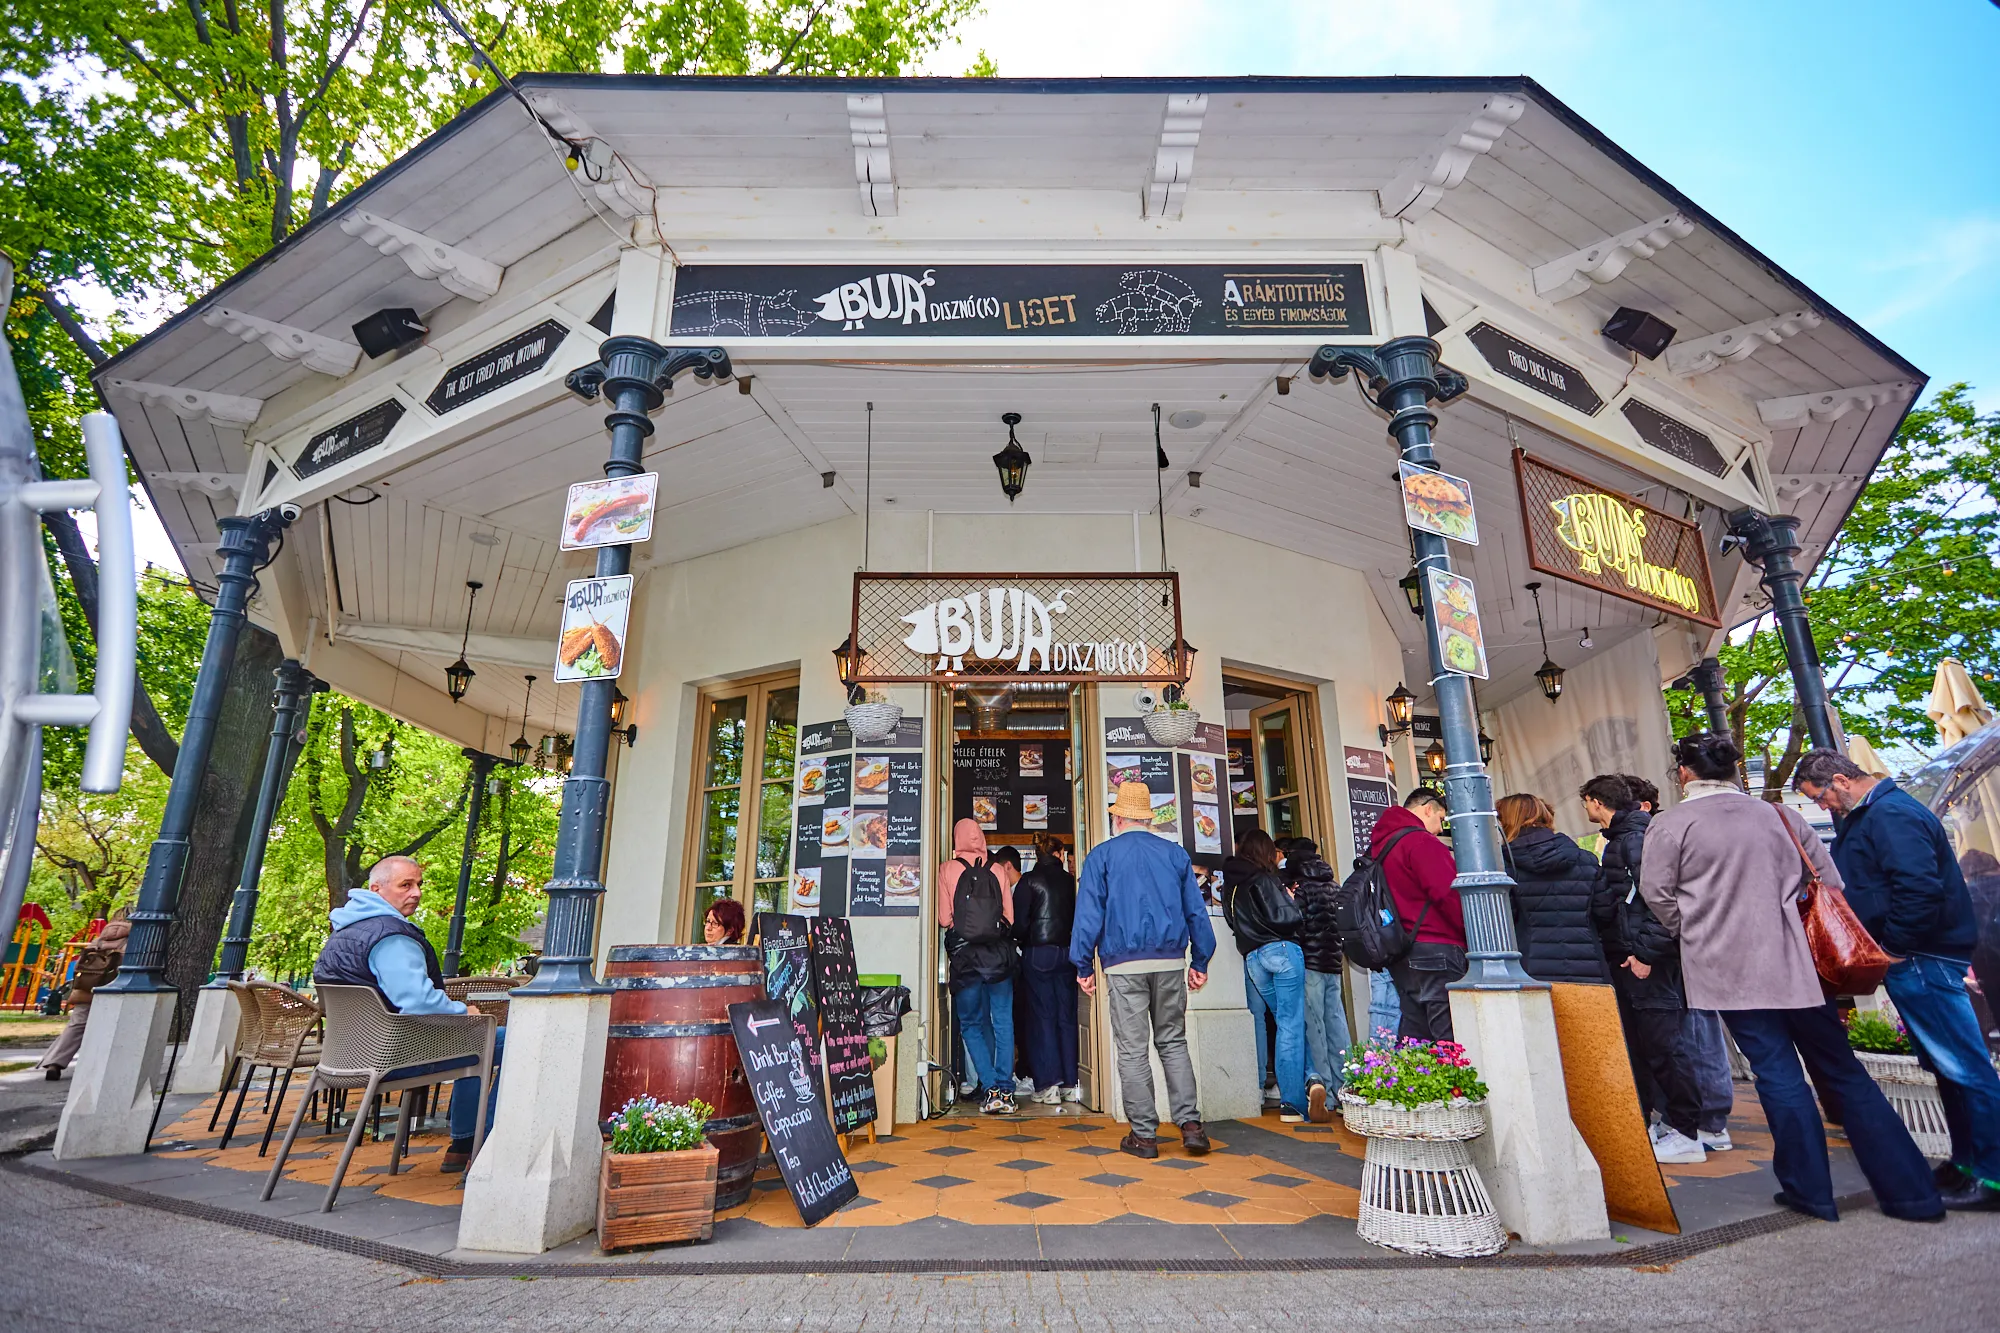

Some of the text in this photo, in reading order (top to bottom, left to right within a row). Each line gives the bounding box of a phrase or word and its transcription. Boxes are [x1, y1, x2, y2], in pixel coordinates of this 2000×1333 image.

[836, 273, 1077, 330] BUJA DISZNÓ(K) LIGET
[1225, 305, 1348, 322] ÉS EGYÉB FINOMSÁGOK
[445, 379, 458, 399] THE
[458, 371, 475, 393] BEST
[475, 361, 496, 385] FRIED
[495, 351, 516, 376] PORK
[1508, 349, 1567, 392] FRIED DUCK LIVER
[576, 582, 603, 609] BUJA
[936, 587, 1148, 674] BUJA DISZNÓ(K)
[890, 761, 906, 770] Fried
[953, 746, 1006, 757] MELEG ÉTELEK
[953, 759, 1001, 768] MAIN DISHES
[888, 824, 918, 832] Duck Liver
[856, 884, 880, 893] from the
[749, 1043, 790, 1072] Drink Bar
[756, 1080, 786, 1112] Coffee
[765, 1106, 813, 1140] Cappuccino
[778, 1147, 801, 1171] Tea
[795, 1175, 818, 1208] Hot
